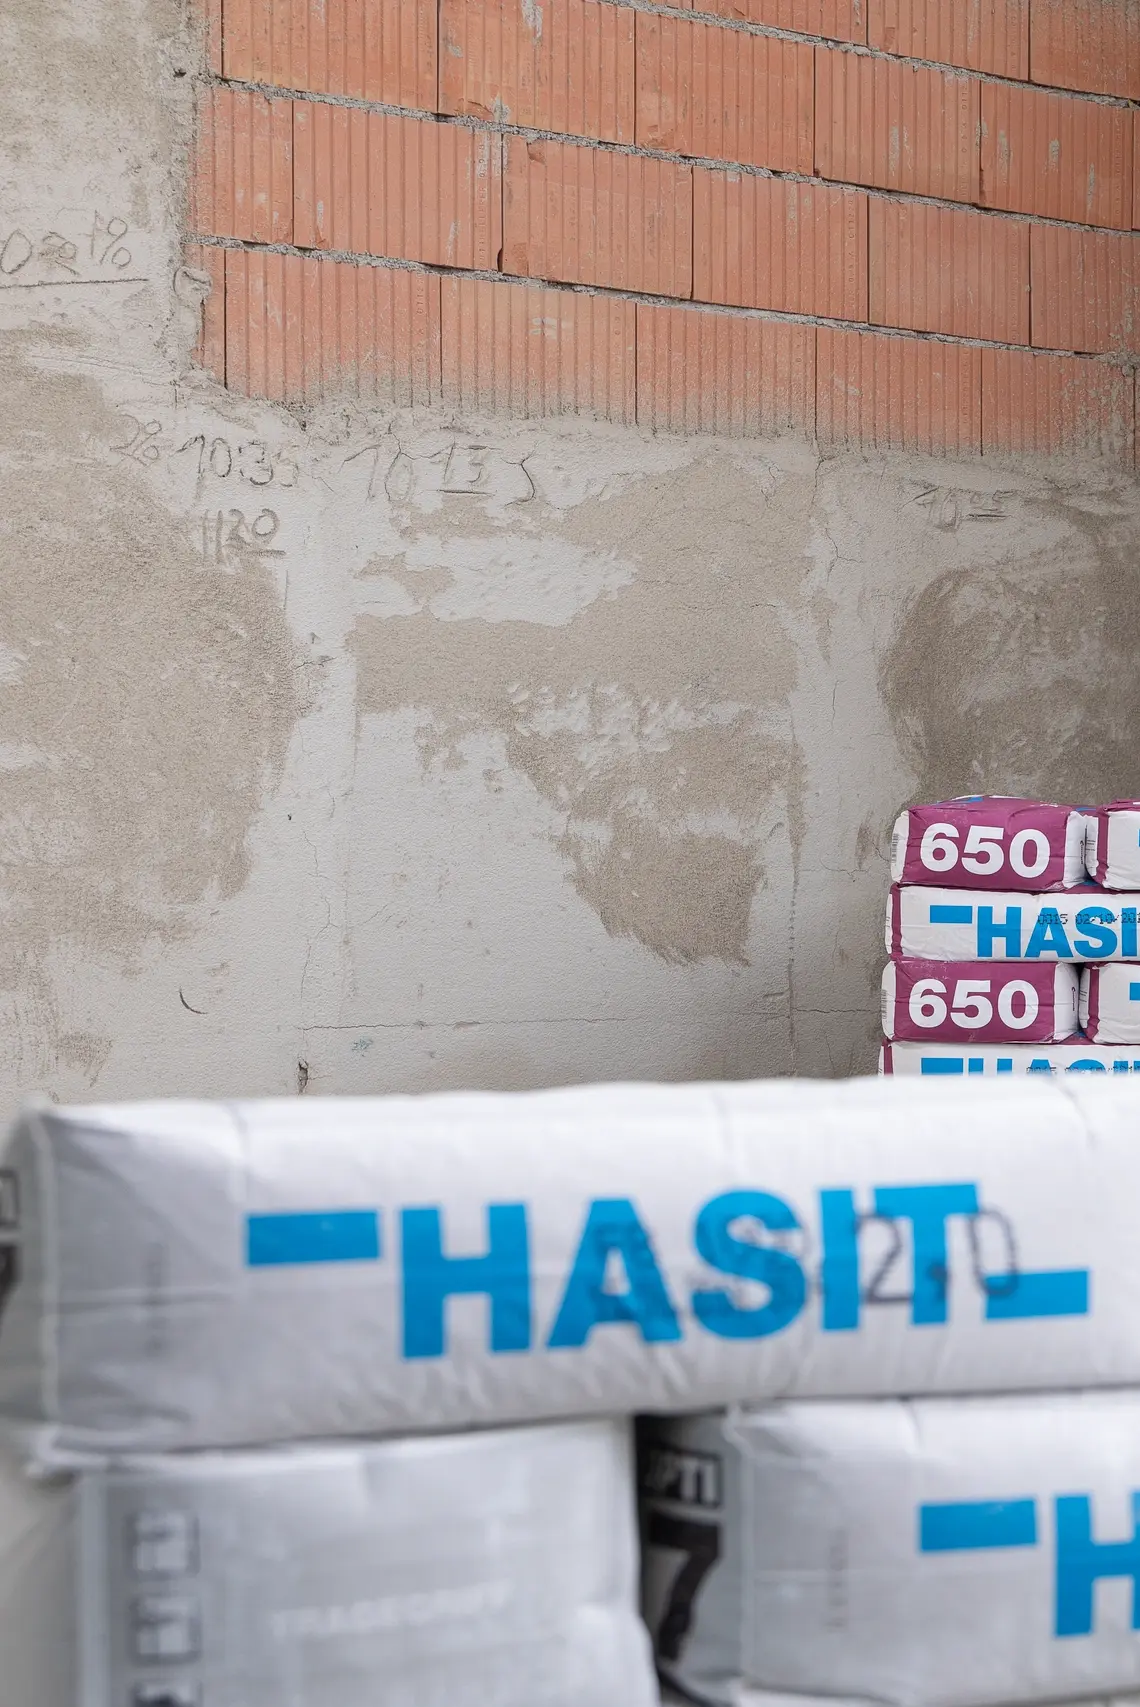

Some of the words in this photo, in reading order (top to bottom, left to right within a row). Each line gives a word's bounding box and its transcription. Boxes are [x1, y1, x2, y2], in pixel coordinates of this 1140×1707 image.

[920, 823, 1051, 878] 650
[909, 979, 1040, 1030] 650
[400, 1183, 981, 1359] HASIT
